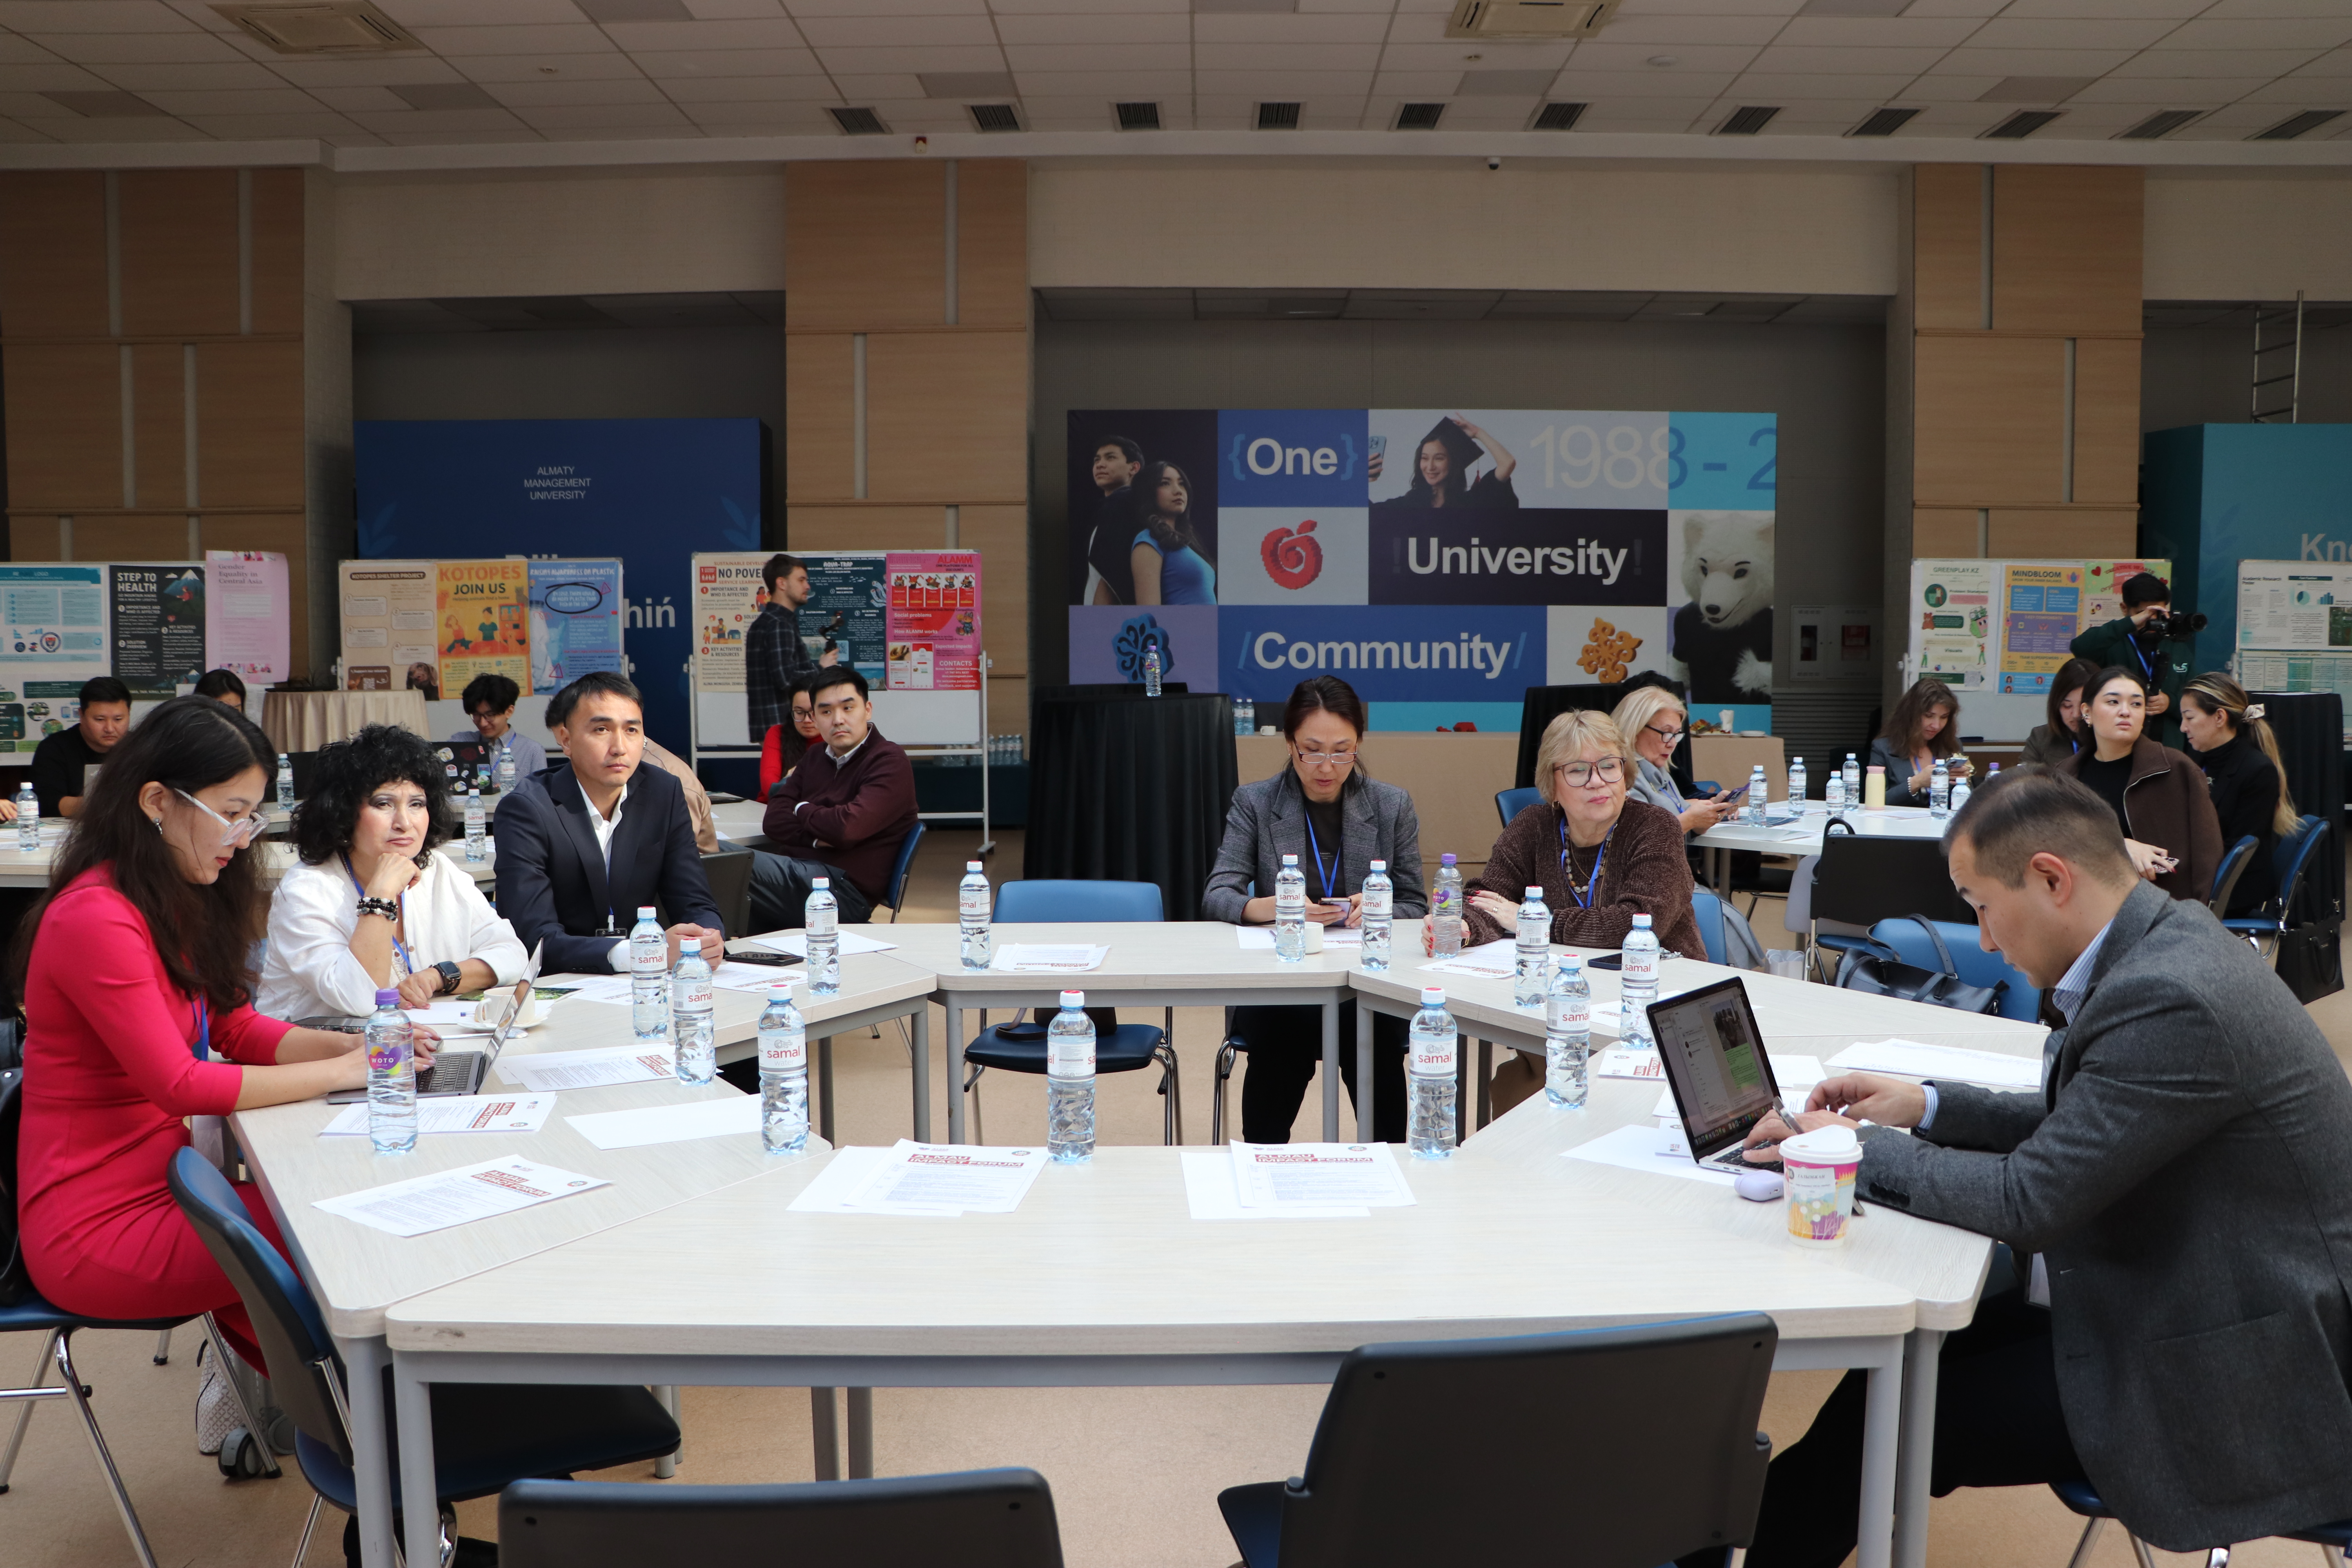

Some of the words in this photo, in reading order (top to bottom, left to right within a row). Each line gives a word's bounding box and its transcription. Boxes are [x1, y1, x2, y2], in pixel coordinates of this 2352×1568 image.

[1530, 425, 1688, 490] 1988
[537, 466, 575, 475] ALMATY
[524, 478, 591, 487] MANAGEMENT
[530, 490, 586, 500] UNIVERSITY
[2301, 534, 2352, 561] Kn
[118, 573, 141, 581] STEP
[144, 573, 156, 581] TO
[439, 565, 521, 581] KOTOPES
[719, 569, 732, 578] NO
[118, 583, 157, 592] HEALTH
[454, 584, 484, 594] JOIN
[489, 583, 505, 593] US
[688, 993, 712, 1002] sama
[767, 1049, 800, 1058] samal
[1418, 1051, 1452, 1063] samal
[488, 1171, 526, 1183] ALMAU
[477, 1174, 511, 1187] IMPACT
[510, 1183, 548, 1196] FORUM
